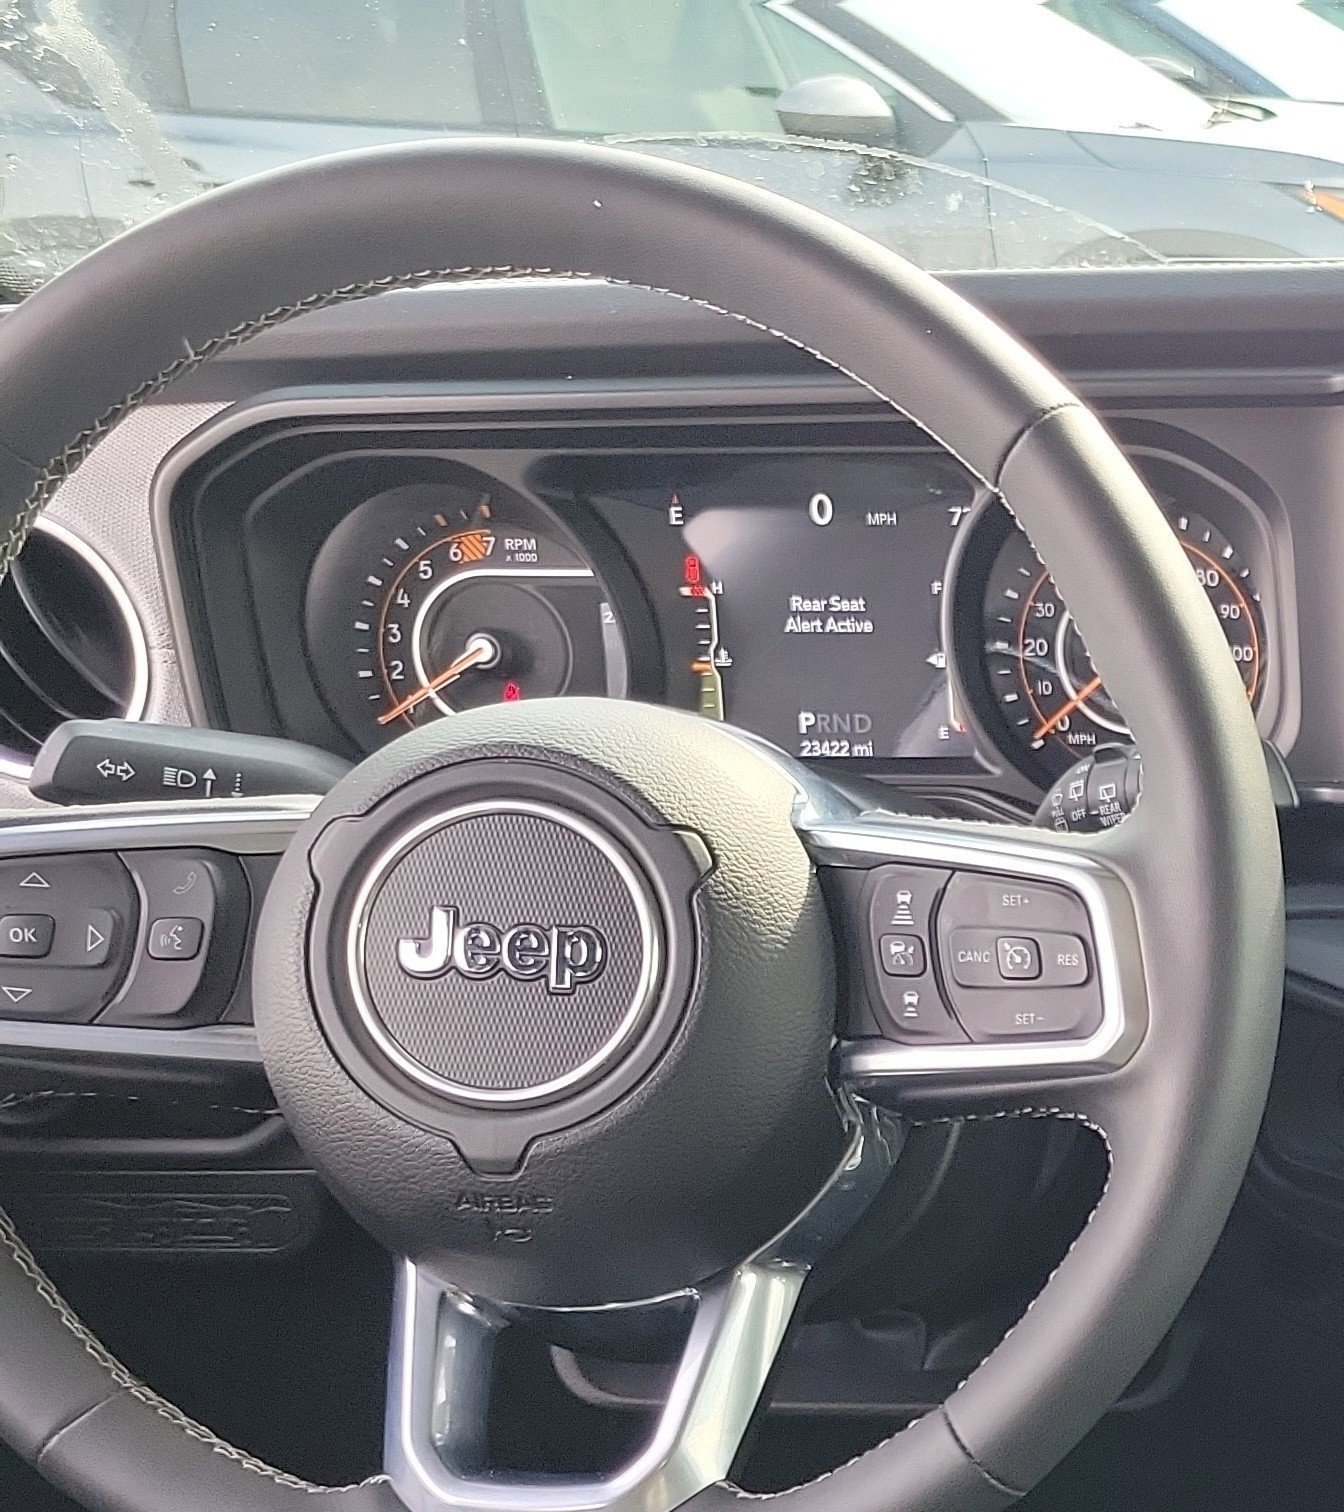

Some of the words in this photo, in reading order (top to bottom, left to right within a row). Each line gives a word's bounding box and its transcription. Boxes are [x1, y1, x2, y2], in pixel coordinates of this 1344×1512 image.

[670, 507, 684, 525] E
[809, 493, 834, 526] 0
[866, 512, 897, 526] MPH
[450, 543, 463, 562] 6
[482, 537, 496, 556] 7
[504, 538, 537, 551] RPM
[515, 553, 538, 563] 1000
[419, 560, 433, 580] 5
[712, 580, 723, 595] H
[931, 580, 942, 595] F
[397, 588, 411, 608] 4
[790, 595, 827, 612] Rear
[829, 596, 866, 612] Seat
[1035, 603, 1055, 618] 30
[1220, 604, 1240, 620] 90
[784, 616, 823, 633] Alert
[825, 616, 874, 633] Active
[388, 623, 402, 643] 3
[1024, 638, 1049, 657] 20
[1232, 646, 1254, 662] 00
[390, 660, 404, 680] 2
[1038, 680, 1053, 696] 10
[938, 726, 949, 739] E
[1068, 733, 1096, 746] MPH
[800, 741, 850, 757] 23422
[854, 740, 873, 757] mi
[1072, 808, 1087, 821] OFF
[1100, 801, 1122, 816] REAR
[9, 927, 38, 943] OK
[399, 905, 604, 992] Jeep
[958, 950, 991, 964] CANC
[1057, 954, 1079, 966] RES
